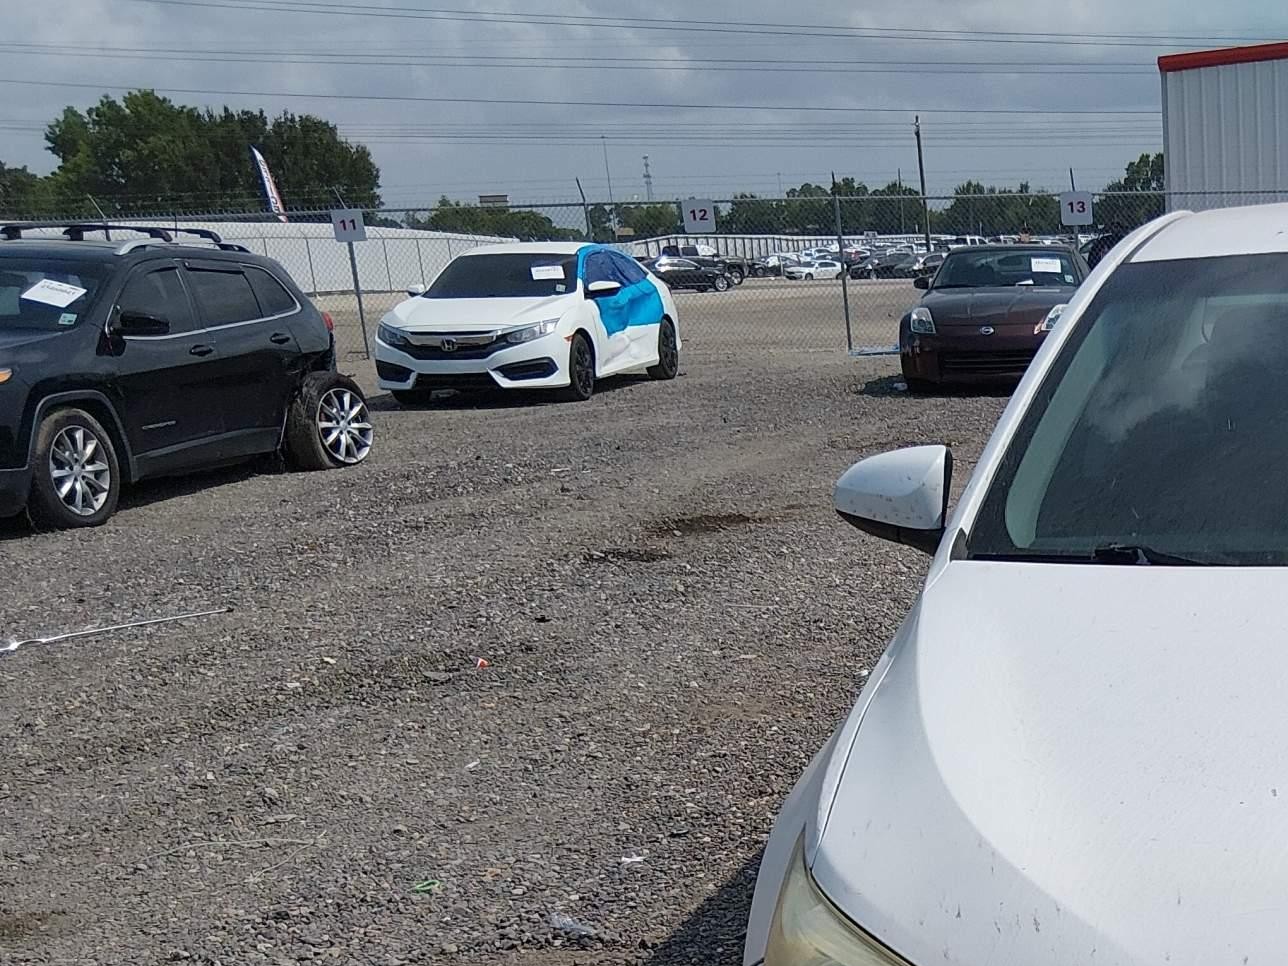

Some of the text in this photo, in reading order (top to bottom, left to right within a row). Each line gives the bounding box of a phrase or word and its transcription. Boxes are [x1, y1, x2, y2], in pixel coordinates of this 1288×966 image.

[1068, 201, 1086, 213] 13
[690, 209, 709, 221] 12
[340, 219, 356, 231] 11
